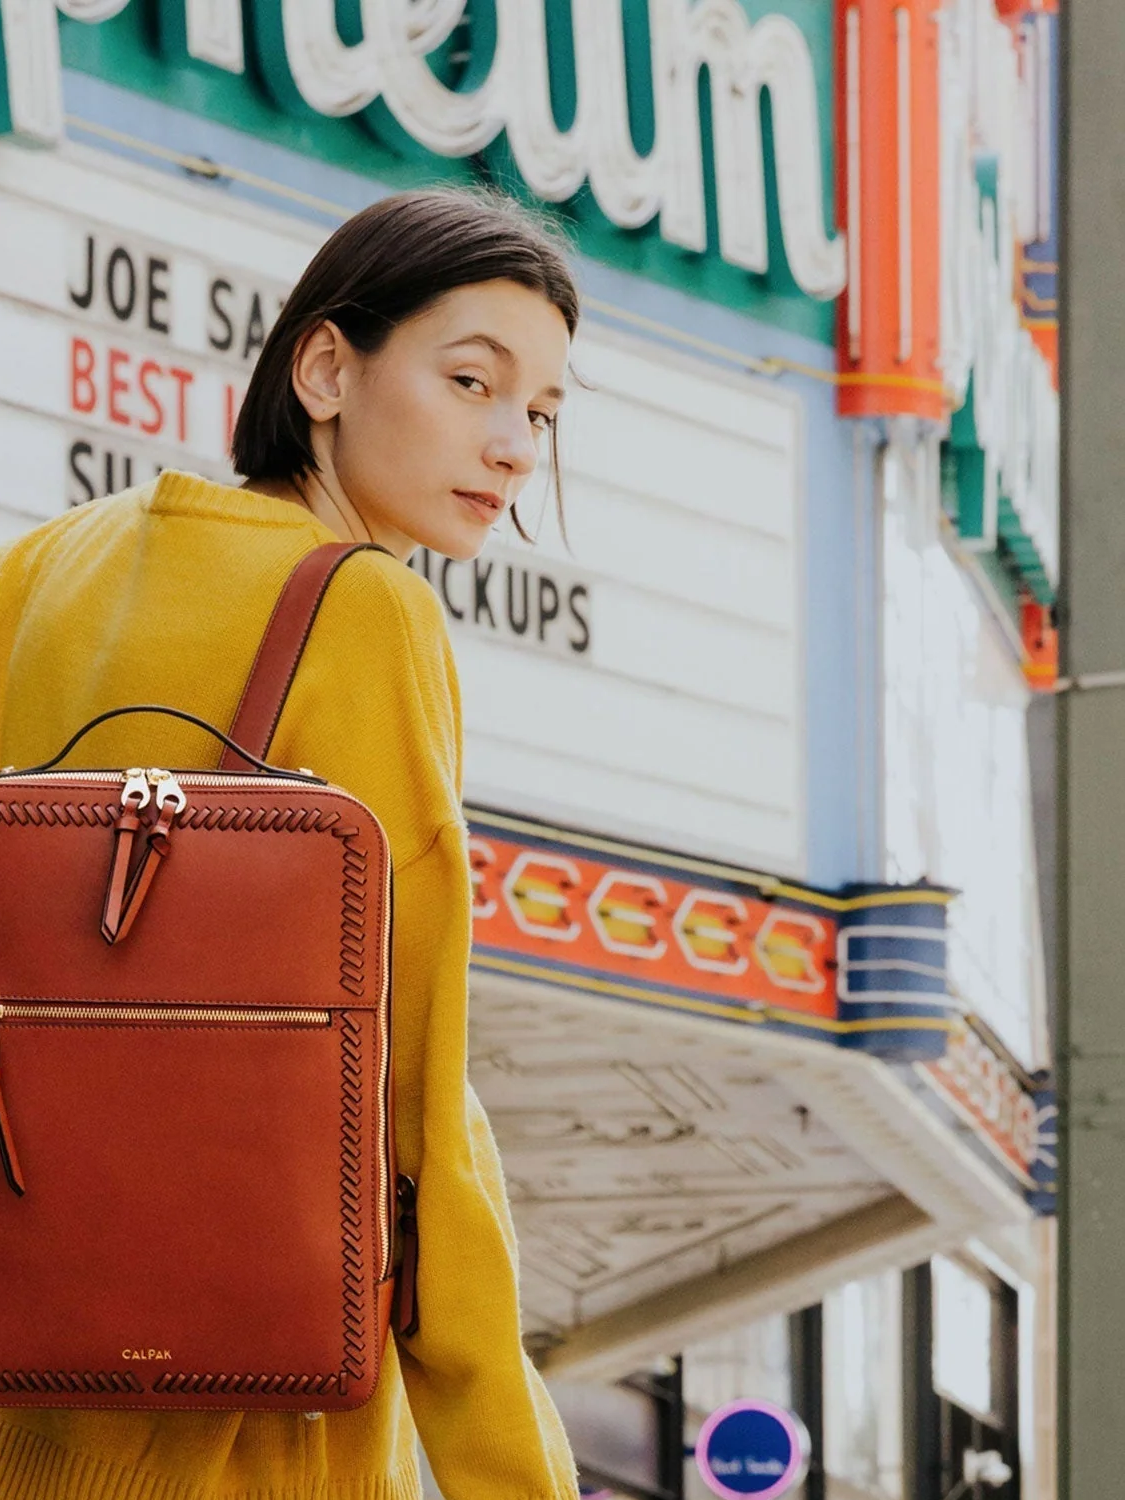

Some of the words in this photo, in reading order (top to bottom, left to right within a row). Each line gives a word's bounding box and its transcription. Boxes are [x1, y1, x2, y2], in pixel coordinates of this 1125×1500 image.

[70, 235, 169, 334] JOE
[208, 278, 285, 360] SA
[70, 337, 195, 442] BEST
[407, 546, 590, 653] CKUPS
[121, 1348, 172, 1360] CALPAK
